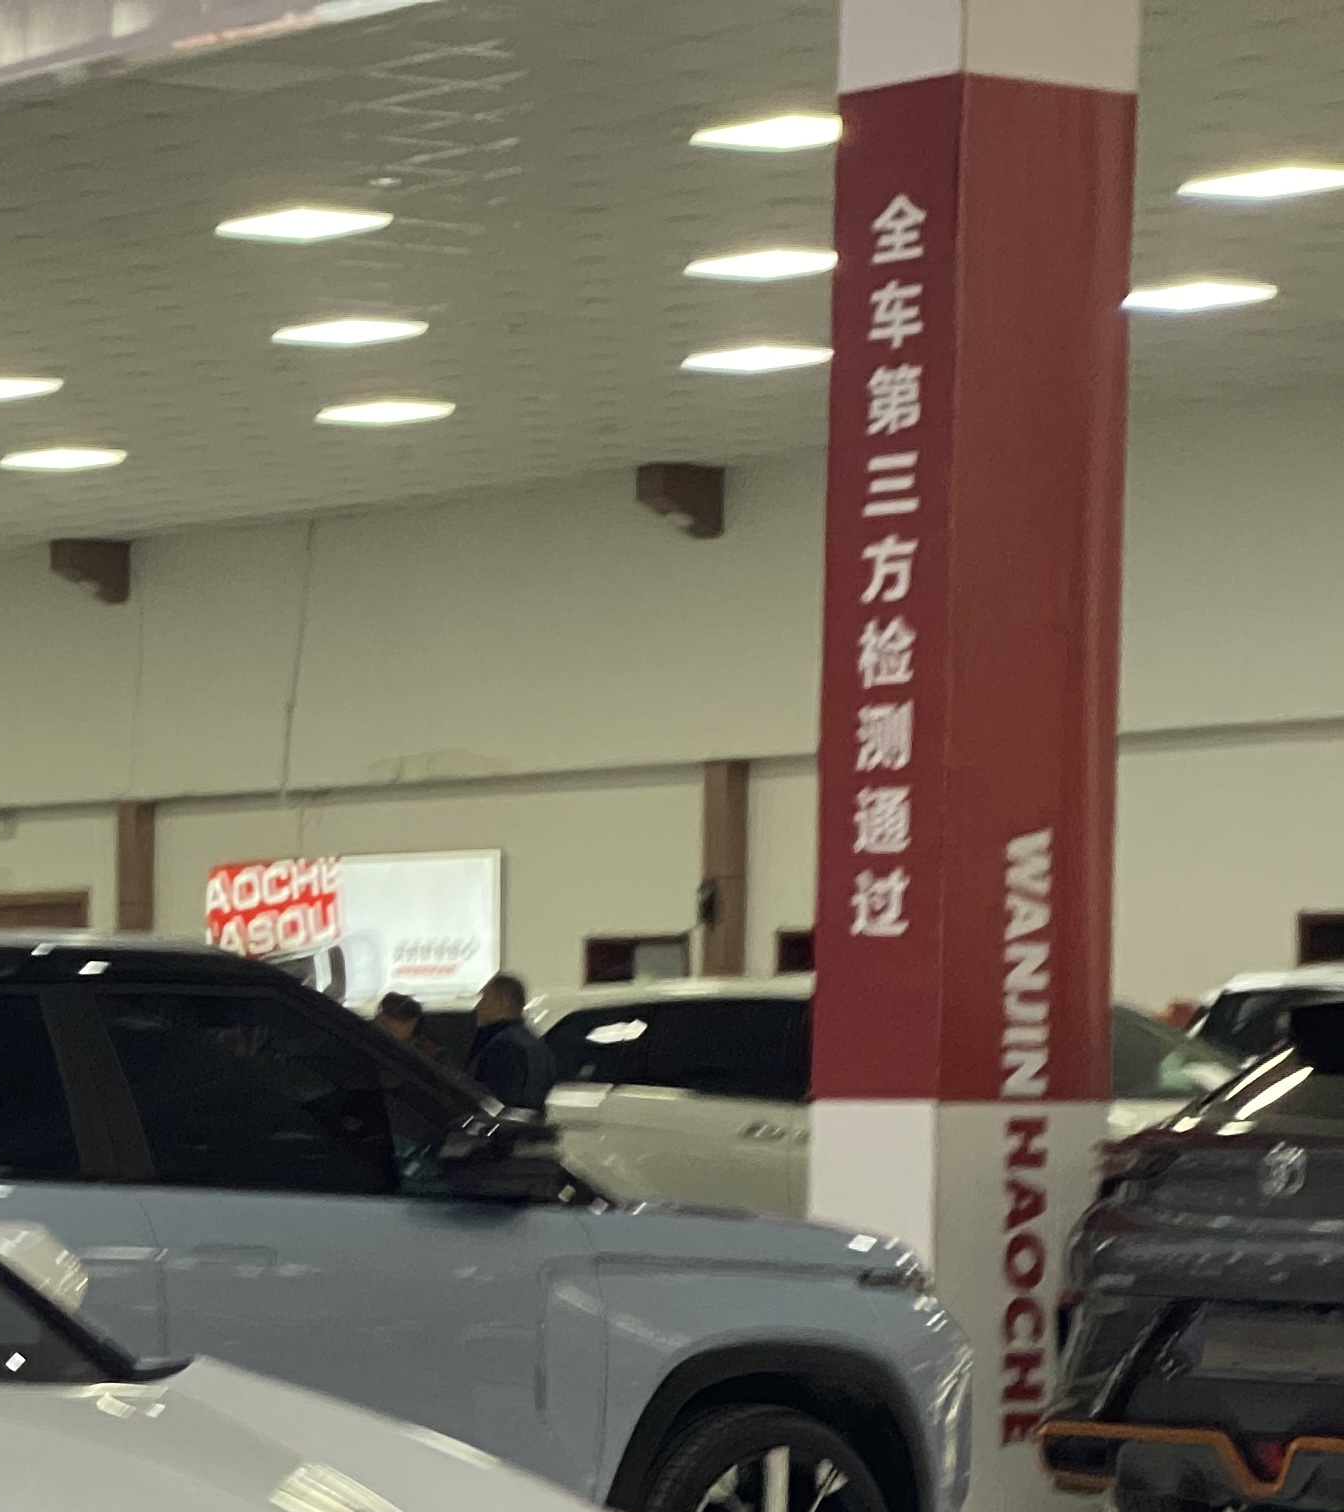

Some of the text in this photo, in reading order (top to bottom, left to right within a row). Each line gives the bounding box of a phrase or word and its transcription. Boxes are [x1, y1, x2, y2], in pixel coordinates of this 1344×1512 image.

[850, 194, 927, 937] 全车第三方检测通过
[1001, 828, 1054, 1447] WANJIN HAOCHE
